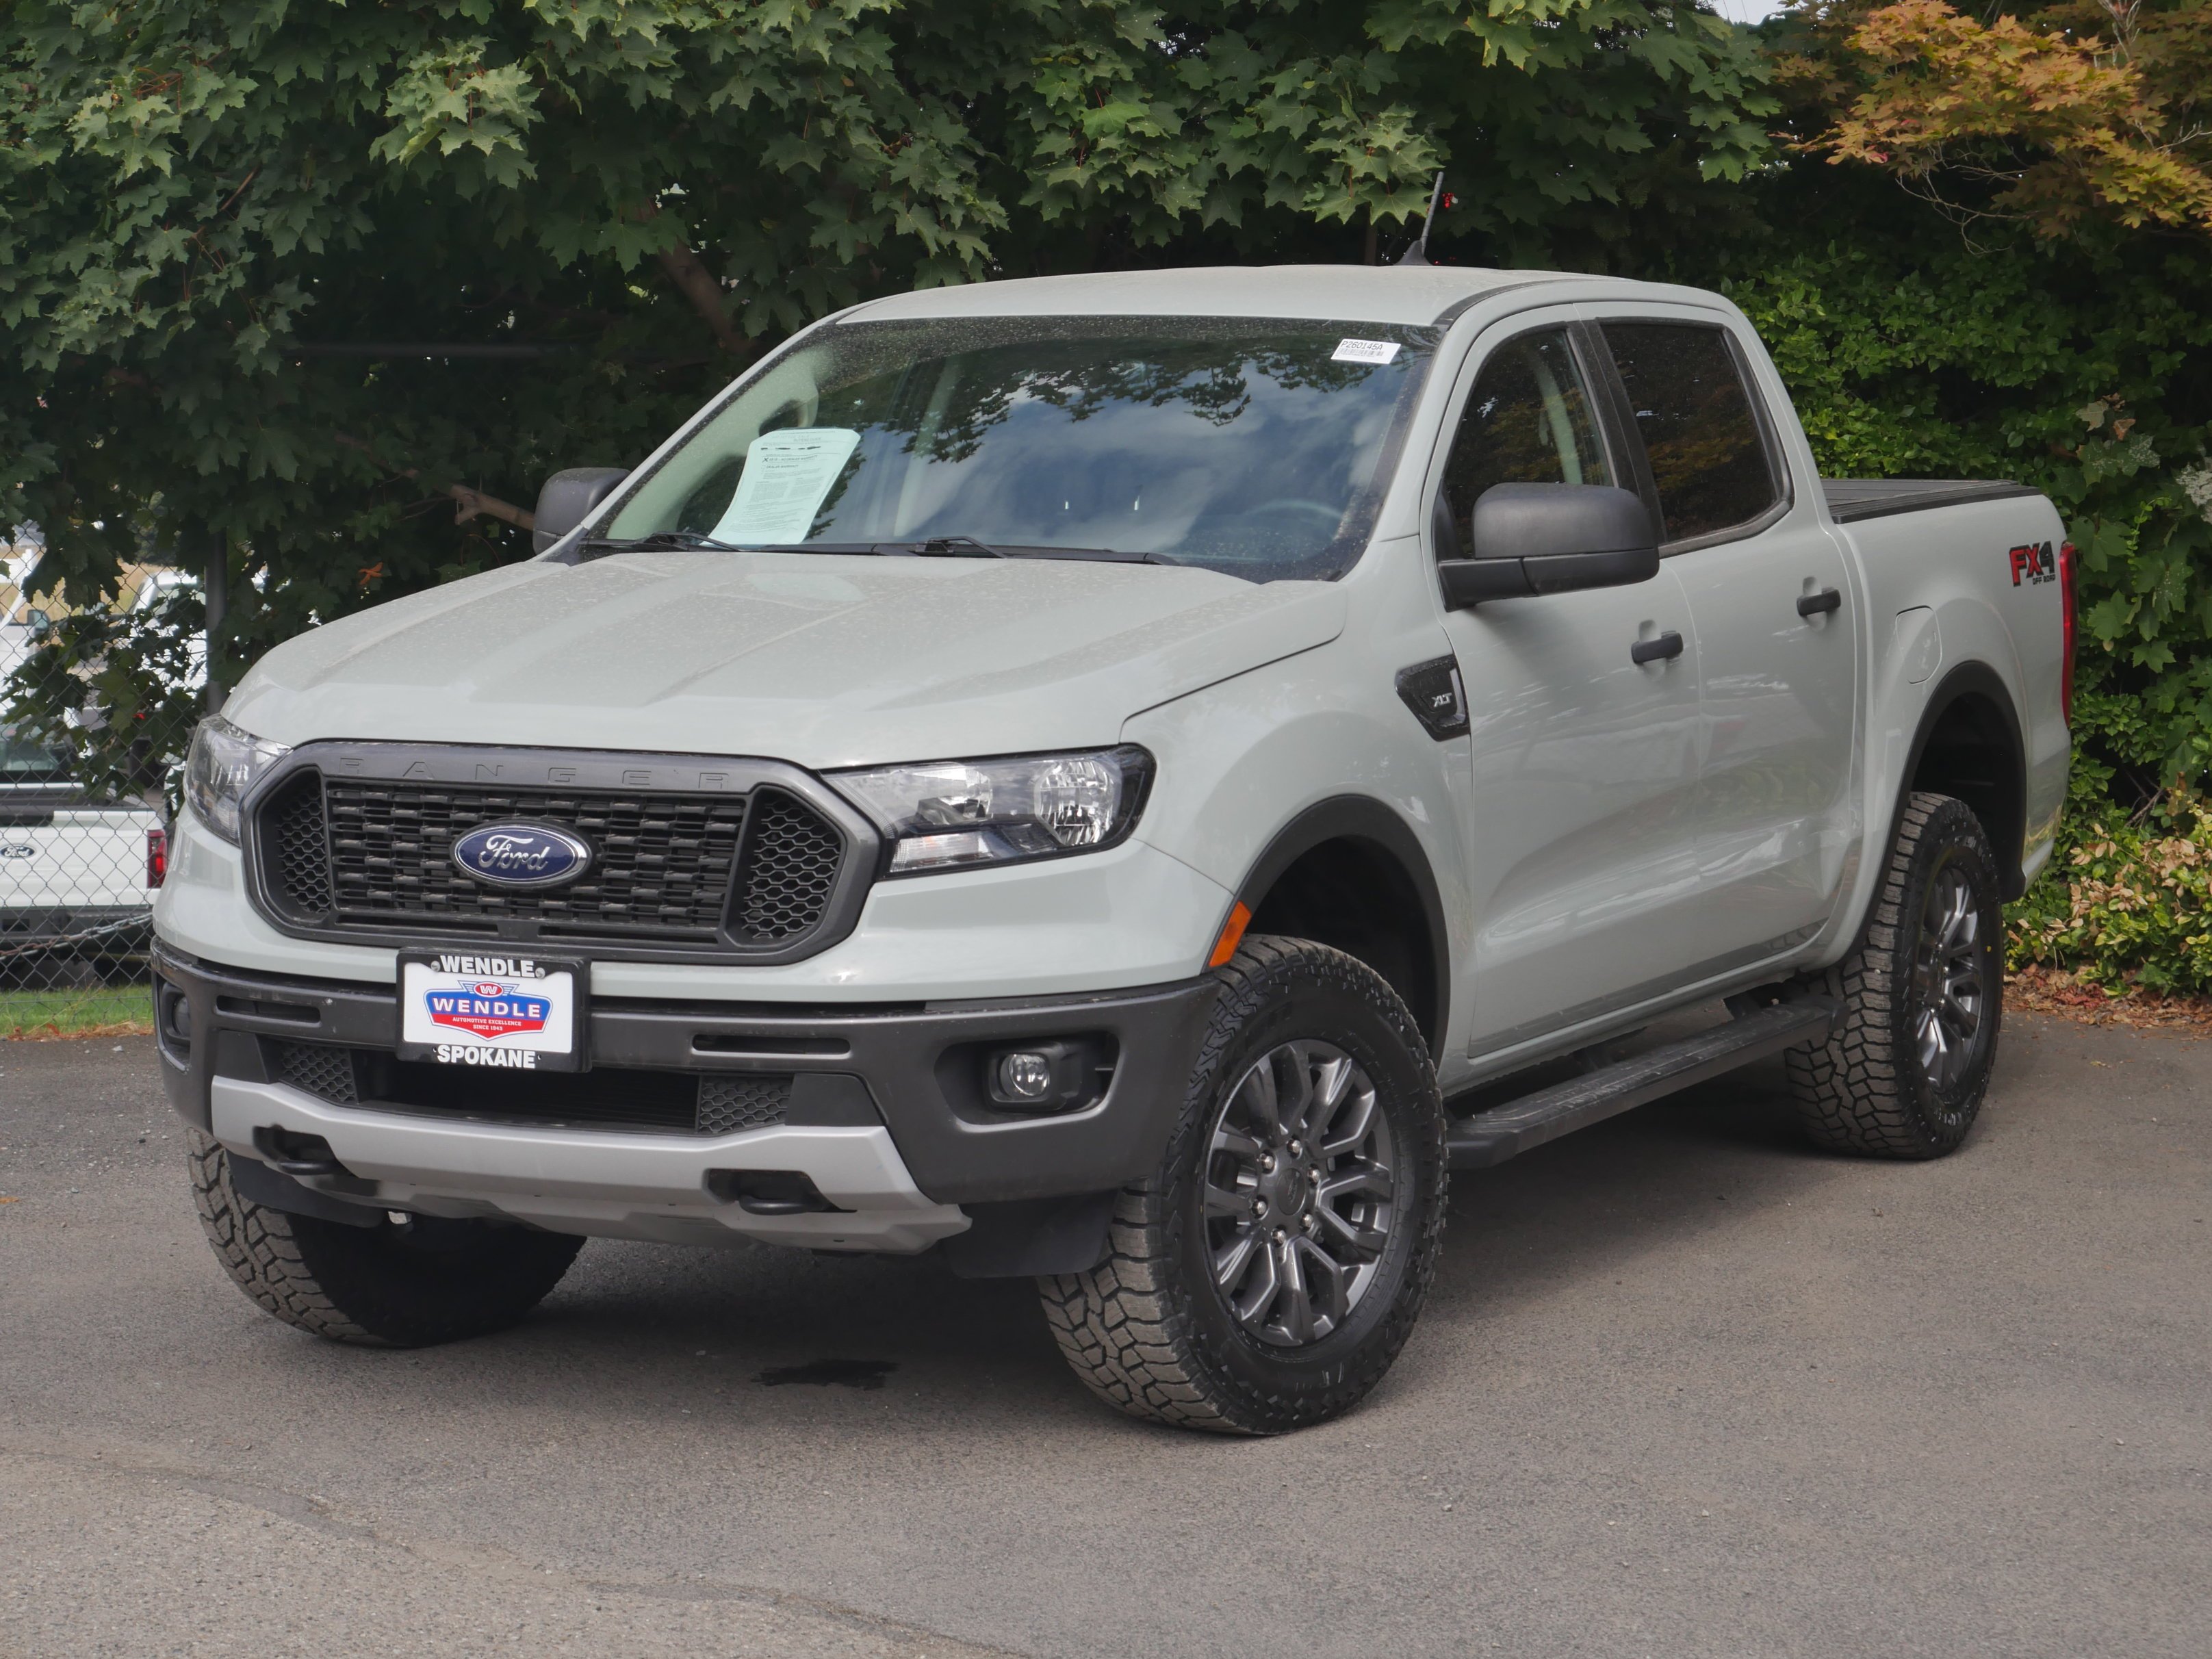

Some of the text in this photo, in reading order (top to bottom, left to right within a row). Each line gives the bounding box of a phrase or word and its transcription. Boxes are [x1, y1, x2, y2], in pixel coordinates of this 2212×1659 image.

[1341, 341, 1383, 350] P260145A
[2009, 540, 2055, 587] FX4
[2033, 574, 2056, 585] OFF ROAD
[1431, 692, 1452, 708] XLT
[339, 758, 730, 789] RANGER
[479, 835, 550, 871] Ford
[440, 955, 536, 978] WENDLE
[480, 985, 498, 995] W
[433, 997, 541, 1018] WENDLE
[437, 1044, 536, 1068] SPOKANE
